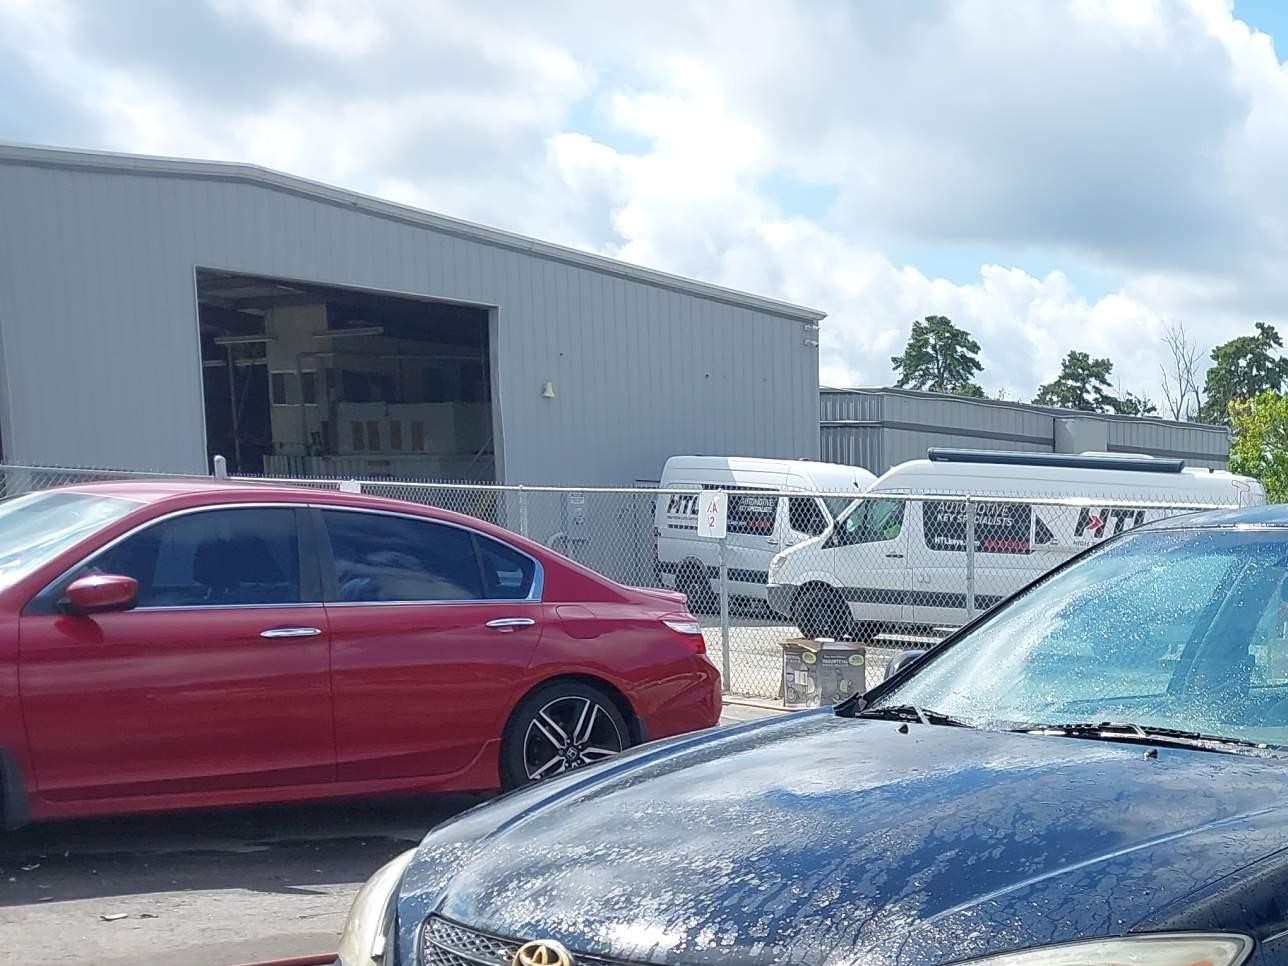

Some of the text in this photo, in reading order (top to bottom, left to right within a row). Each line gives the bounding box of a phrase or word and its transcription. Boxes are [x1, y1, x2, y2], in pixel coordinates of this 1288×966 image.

[936, 501, 1010, 517] AUTOOTIVE
[708, 516, 716, 528] 2
[957, 514, 1013, 527] SPCIALISTS
